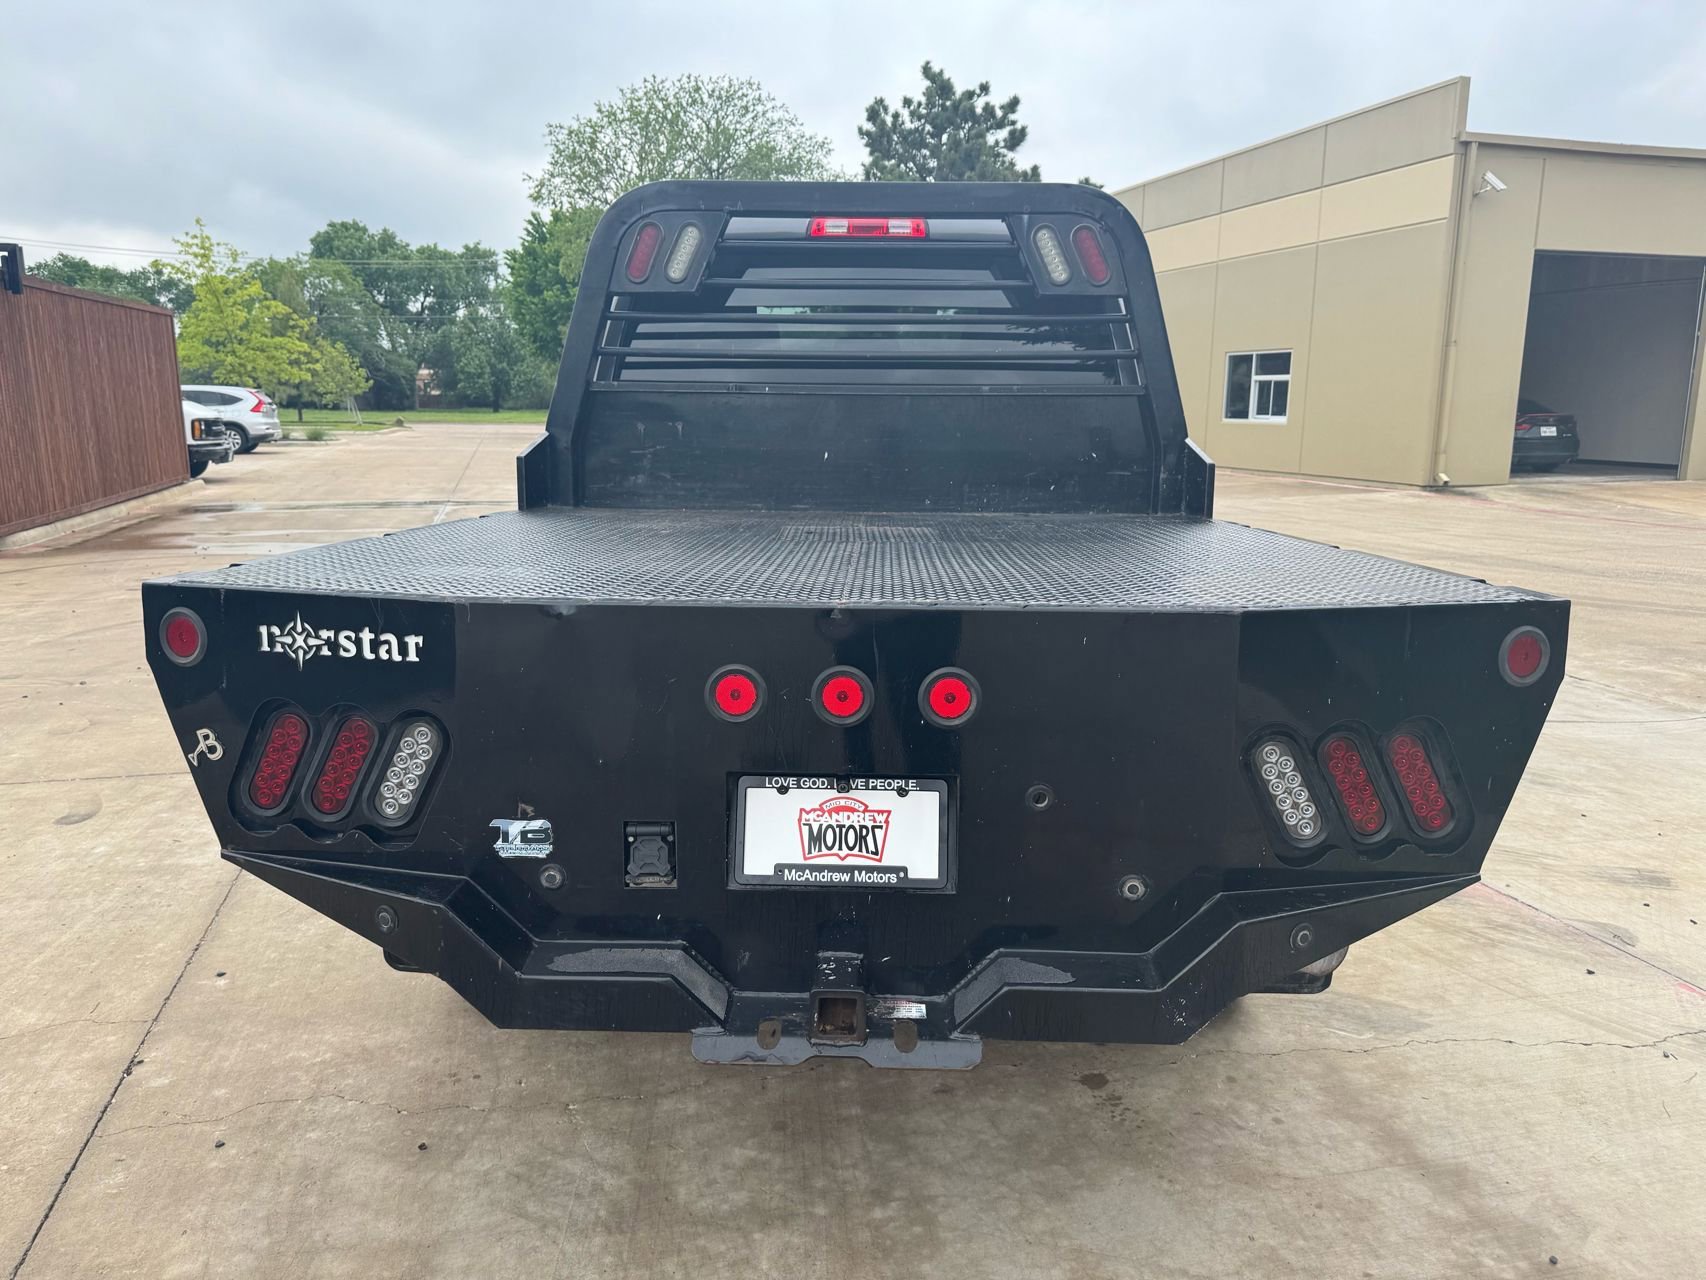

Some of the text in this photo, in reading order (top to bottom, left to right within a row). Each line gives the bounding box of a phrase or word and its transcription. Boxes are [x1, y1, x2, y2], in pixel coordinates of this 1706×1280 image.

[258, 614, 424, 669] norstar
[765, 777, 920, 791] LOVE GOD. LVE PEOPLE.
[825, 800, 863, 809] MID CITY
[802, 822, 884, 857] MOTORS
[784, 868, 898, 883] McAndrew Motors
